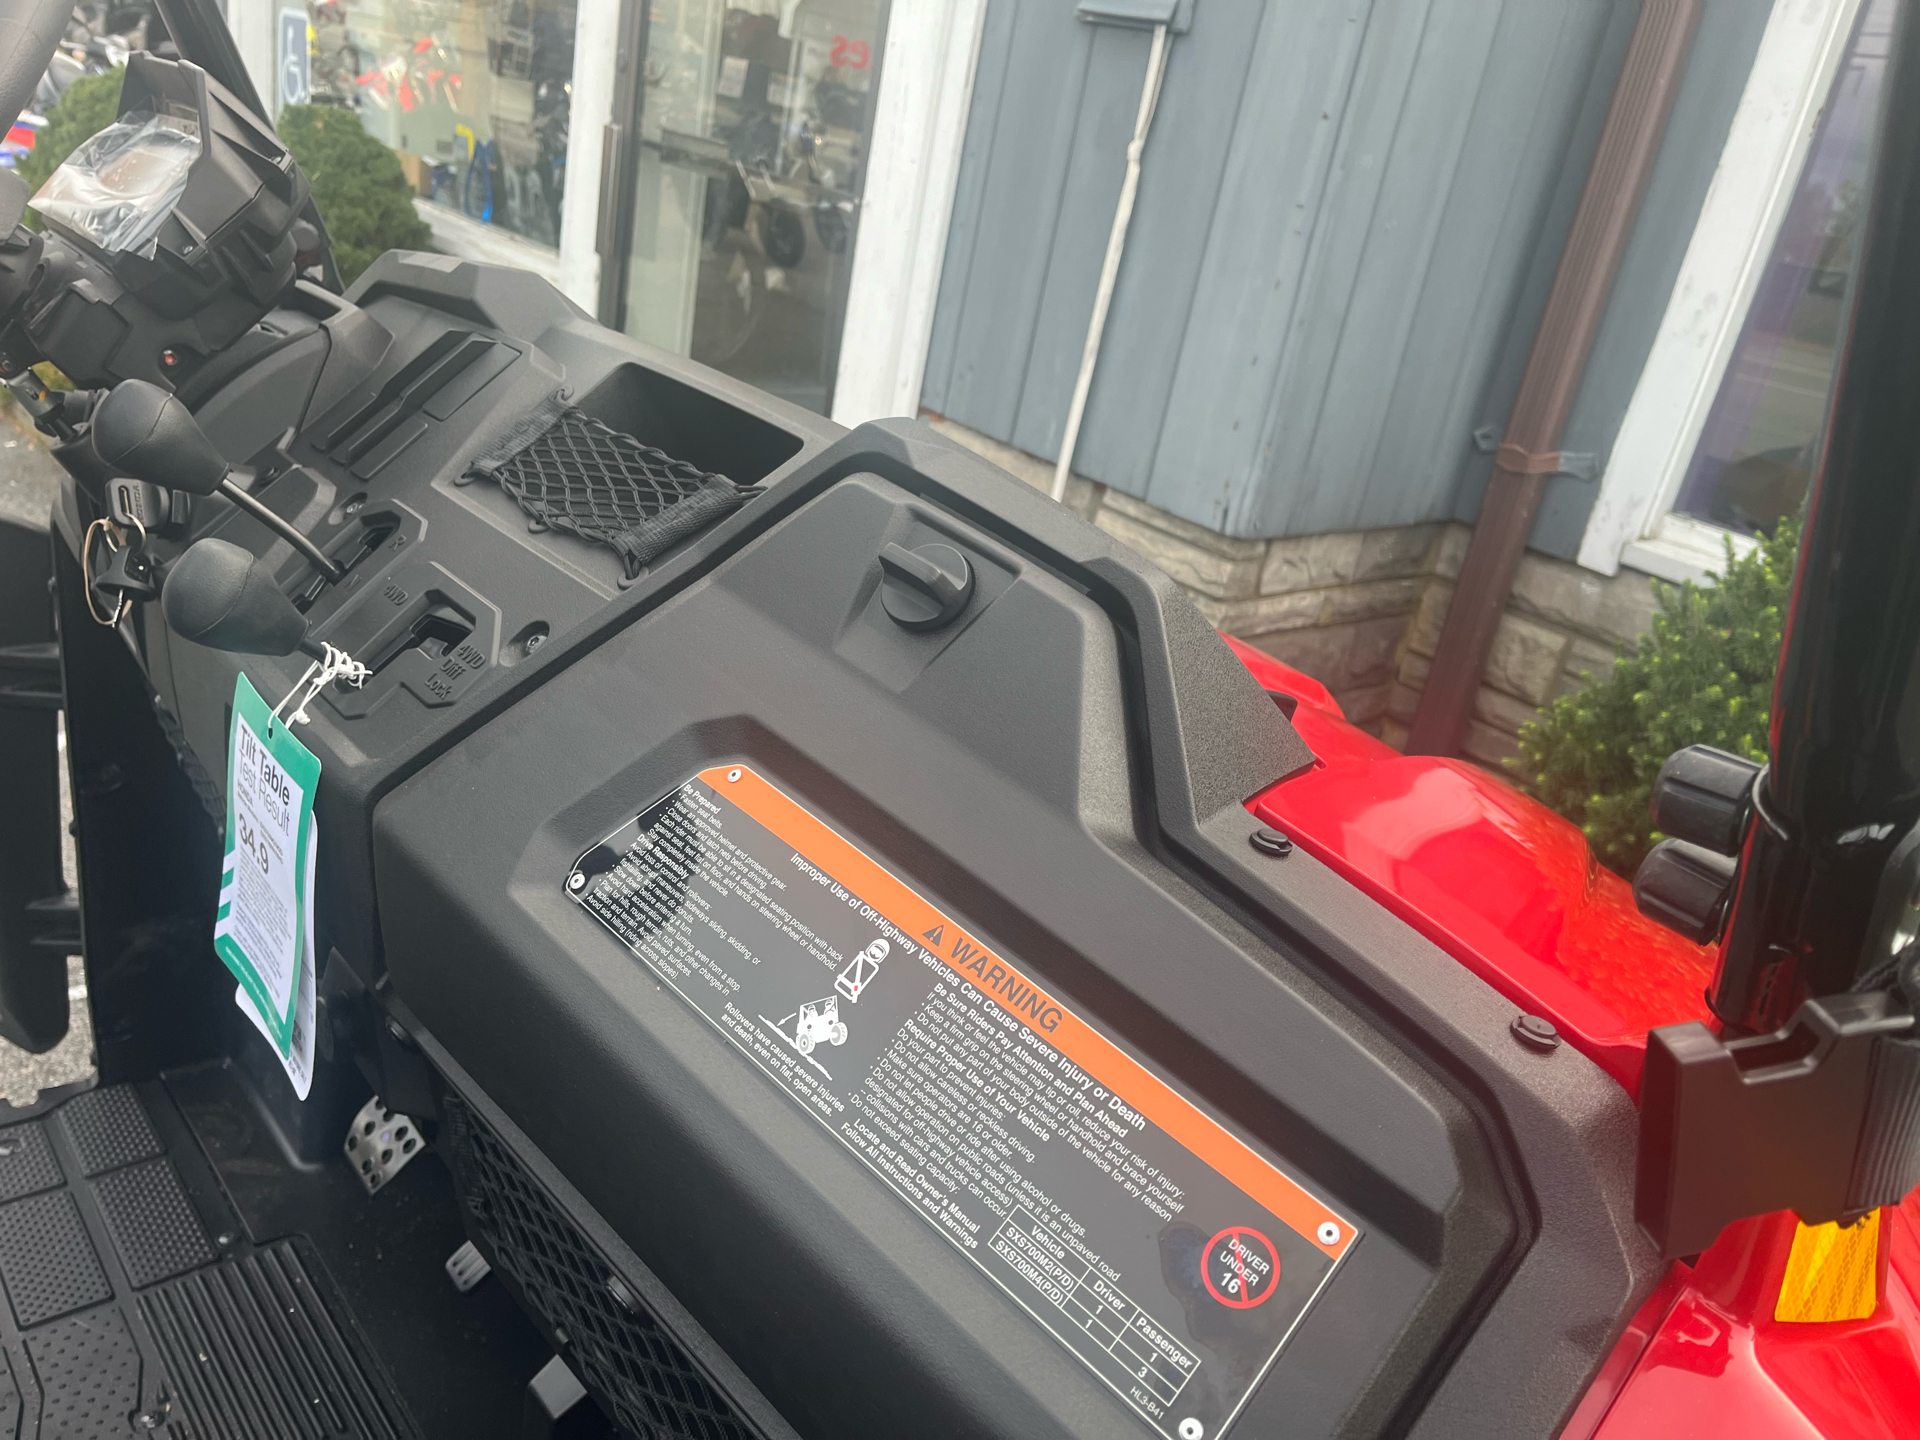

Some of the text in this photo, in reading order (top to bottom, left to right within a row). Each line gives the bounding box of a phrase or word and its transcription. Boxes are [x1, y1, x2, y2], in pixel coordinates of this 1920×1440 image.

[388, 534, 407, 551] R
[383, 584, 409, 606] 4WD
[424, 673, 453, 699] Lock
[440, 657, 466, 680] Diff
[459, 644, 486, 669] 4WD
[239, 749, 257, 794] Test
[258, 778, 290, 837] Result
[240, 724, 257, 766] Tilt
[259, 748, 290, 806] Table
[679, 793, 722, 830] Fasten seat belts.
[682, 783, 721, 814] Be Prepared
[239, 812, 269, 875] 34.9
[636, 833, 689, 879] Drive Responsibly
[613, 864, 627, 879] Slow
[625, 876, 640, 890] down
[638, 886, 656, 904] before
[654, 901, 676, 923] entering
[679, 921, 692, 936] turn.
[630, 841, 712, 911] Avoid loss of control and rollovers:
[592, 886, 691, 977] traction and terrain. Avoid paved surfaces.
[790, 852, 1145, 1130] Improper Use of Off-Highway Vehicles Can Cause Severe Injury or Death
[951, 944, 1063, 1034] WARNING
[721, 1013, 832, 1117] and death, even on flat, open areas.
[724, 1001, 844, 1112] Rollovers have caused severe injuries
[896, 1027, 1006, 1122] Do your part to prevent injuries:
[903, 1018, 1050, 1141] Require Proper Use of Your Vehicle
[933, 982, 1128, 1138] Be Sure Riders Pay Attention and Plan Ahead
[886, 1048, 1013, 1160] Make sure operators are 16 or older.
[893, 1040, 1035, 1163] Do not allow careless or reckless driving.
[850, 1093, 961, 1194] Do not exceed seating capacity:
[864, 1077, 1013, 1207] designated for off-highway vehicle access)
[865, 1093, 1007, 1220] collisions with cars and trucks can occur.
[879, 1057, 1086, 1238] Do not let people drive or ride after using alcohol or drugs.
[840, 1121, 978, 1248] Follow All Instructions and Warnings
[853, 1118, 980, 1233] Locate and Read Owner's Manual
[992, 1240, 1063, 1305] SXS700M4(P/D)
[1005, 1226, 1074, 1290] SXS700M2(P/D)
[1031, 1224, 1064, 1259] Vehicle
[1219, 1250, 1259, 1286] UNDER
[1227, 1238, 1269, 1274] DRIVER
[1092, 1279, 1125, 1310] Driver
[1095, 1304, 1103, 1314] 1
[1220, 1272, 1241, 1293] 16
[1084, 1318, 1093, 1328] 1
[1135, 1316, 1192, 1368] Passenger
[1137, 1366, 1147, 1378] 3
[1149, 1352, 1158, 1362] 1
[1129, 1385, 1164, 1419] HL3-B41
